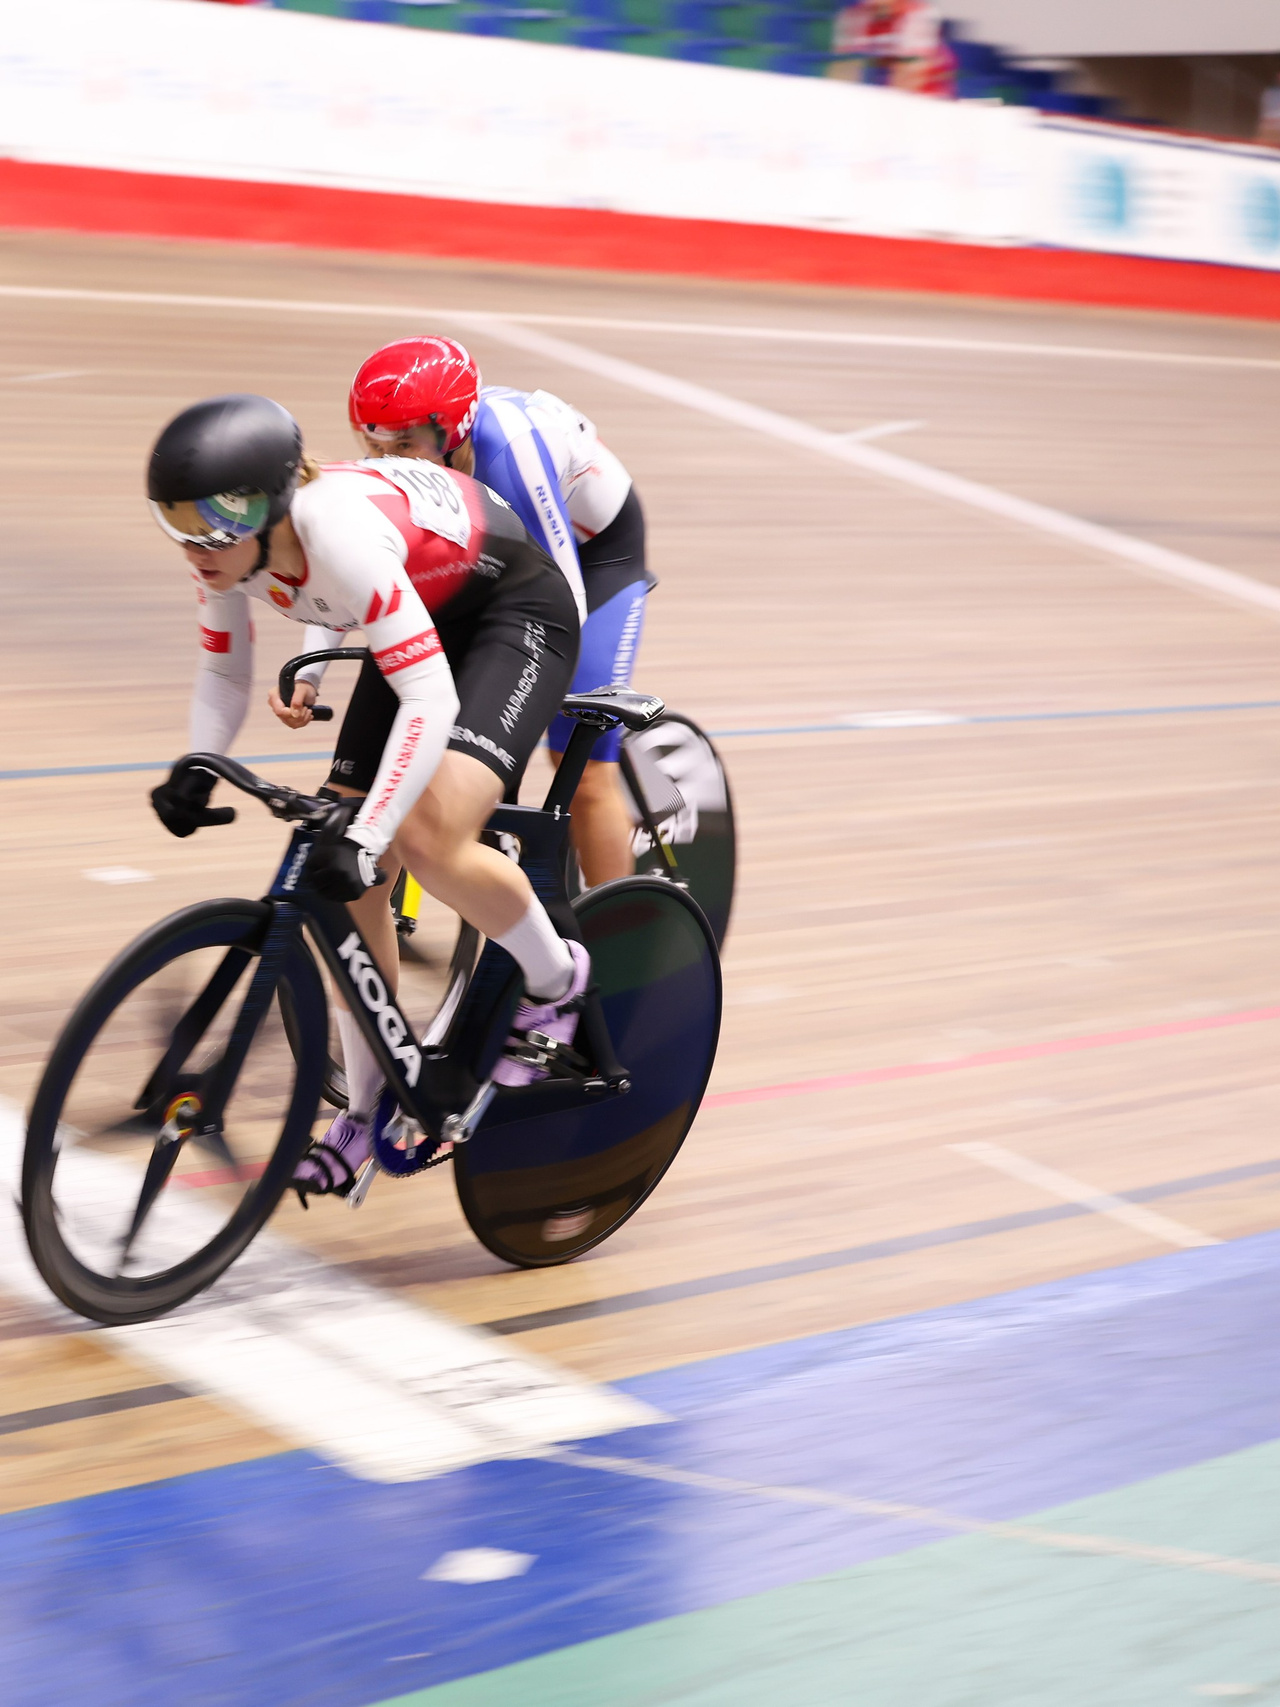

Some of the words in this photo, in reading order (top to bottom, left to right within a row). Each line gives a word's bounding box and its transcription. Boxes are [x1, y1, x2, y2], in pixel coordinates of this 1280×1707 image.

[457, 400, 479, 439] KA
[391, 469, 460, 514] 198
[536, 485, 566, 548] RUSSIA
[447, 725, 518, 772] EMME
[281, 842, 314, 891] KOGA
[336, 931, 423, 1089] KOGA
